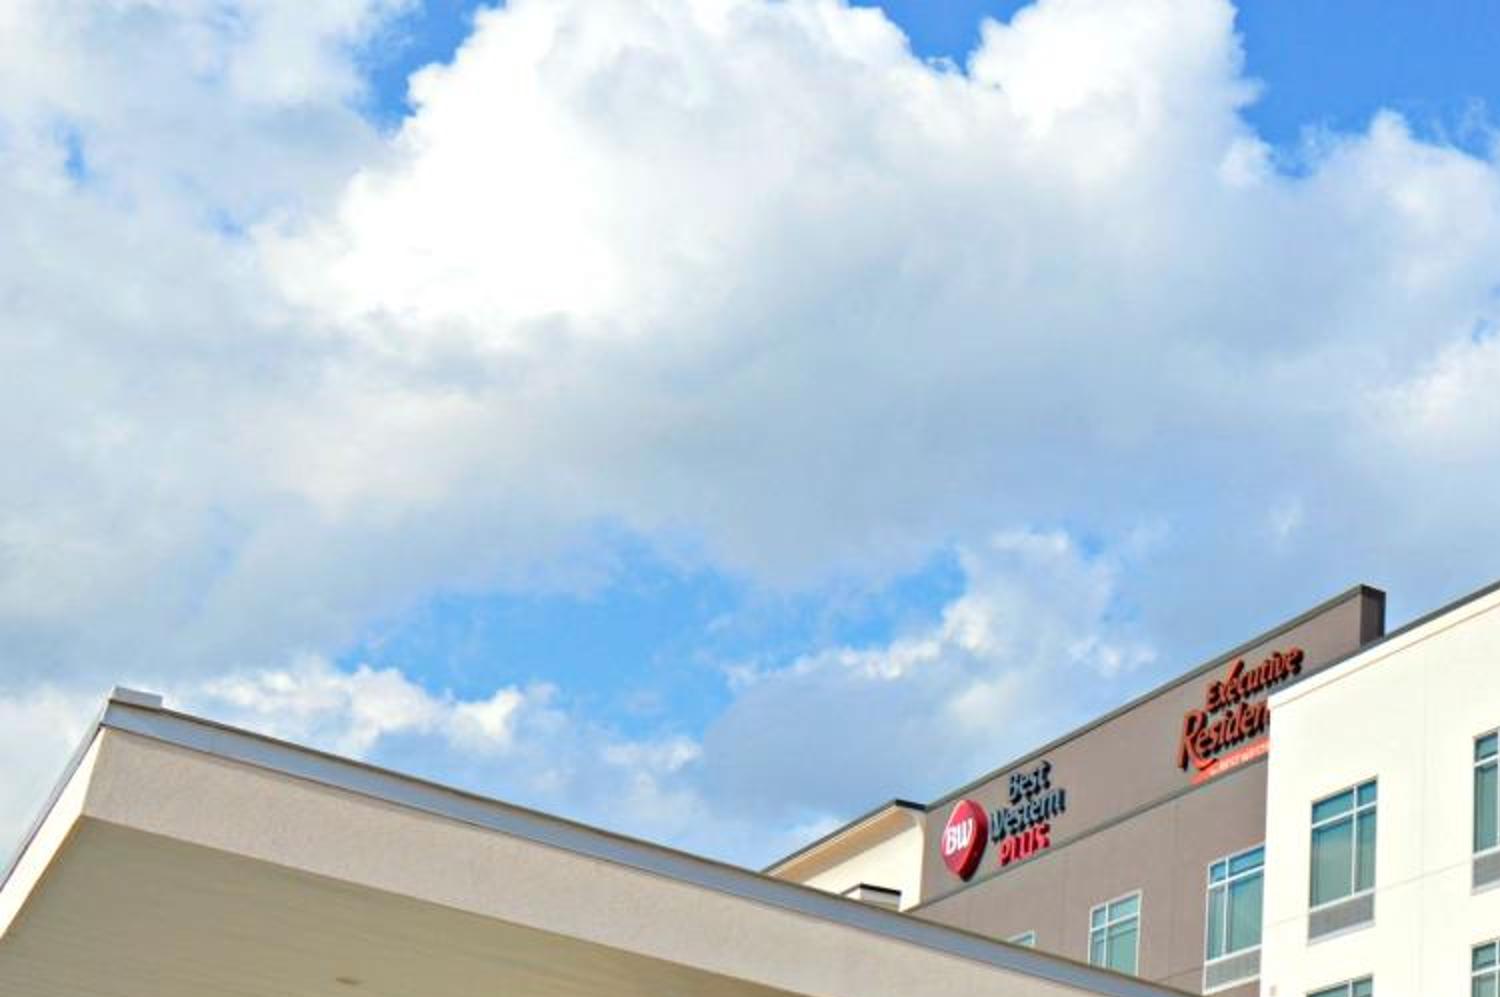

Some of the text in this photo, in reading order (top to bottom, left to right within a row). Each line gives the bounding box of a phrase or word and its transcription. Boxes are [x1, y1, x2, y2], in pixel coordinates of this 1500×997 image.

[1206, 647, 1304, 713] Executive
[1177, 699, 1270, 772] Residen
[1009, 761, 1051, 804] Best
[945, 817, 974, 856] BW
[991, 788, 1066, 843] Western
[998, 823, 1050, 866] PLUS
